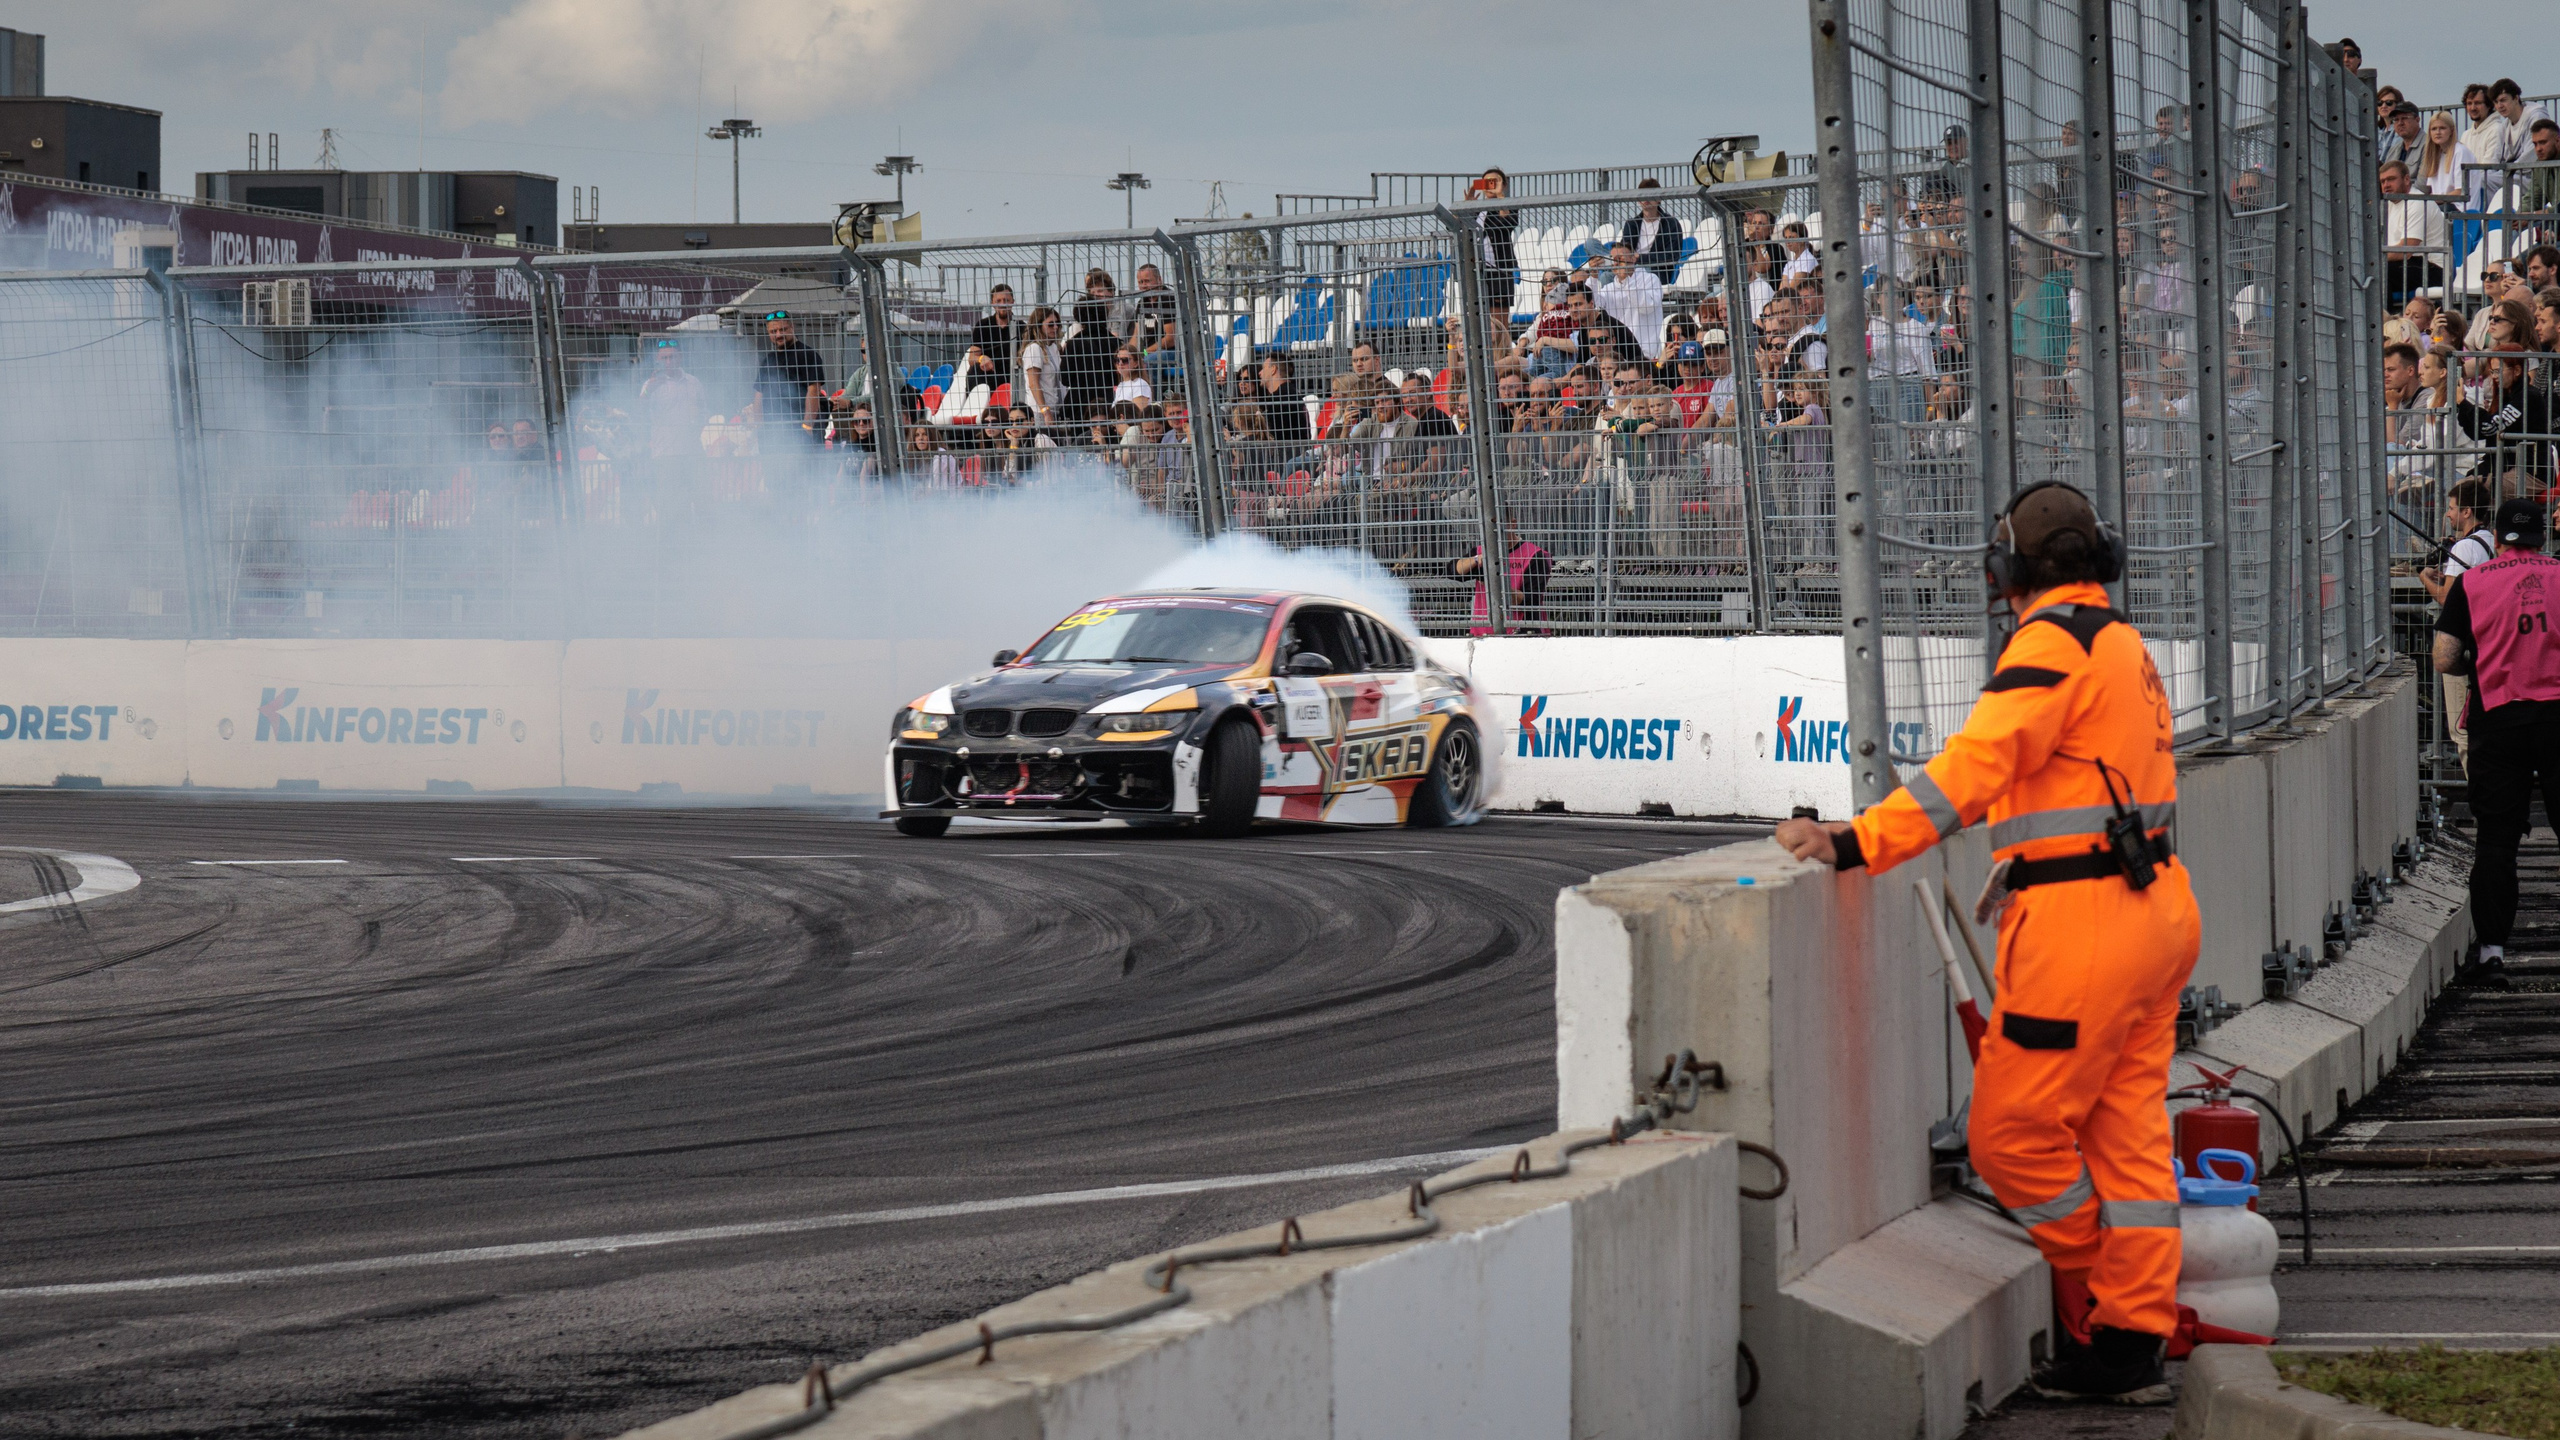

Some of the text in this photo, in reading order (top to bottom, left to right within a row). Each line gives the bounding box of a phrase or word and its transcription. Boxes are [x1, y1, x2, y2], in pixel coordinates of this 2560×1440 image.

[47, 210, 94, 255] ИГОРА
[211, 230, 253, 266] ИГОРА
[357, 248, 395, 287] ИГОРА
[1054, 607, 1119, 632] 98
[2517, 611, 2548, 635] 01
[0, 704, 118, 741] OREST
[255, 687, 488, 745] KINFOREST
[621, 687, 826, 748] KINFOREST
[1517, 694, 1681, 761] KINFOREST
[1333, 732, 1430, 785] ISKRA
